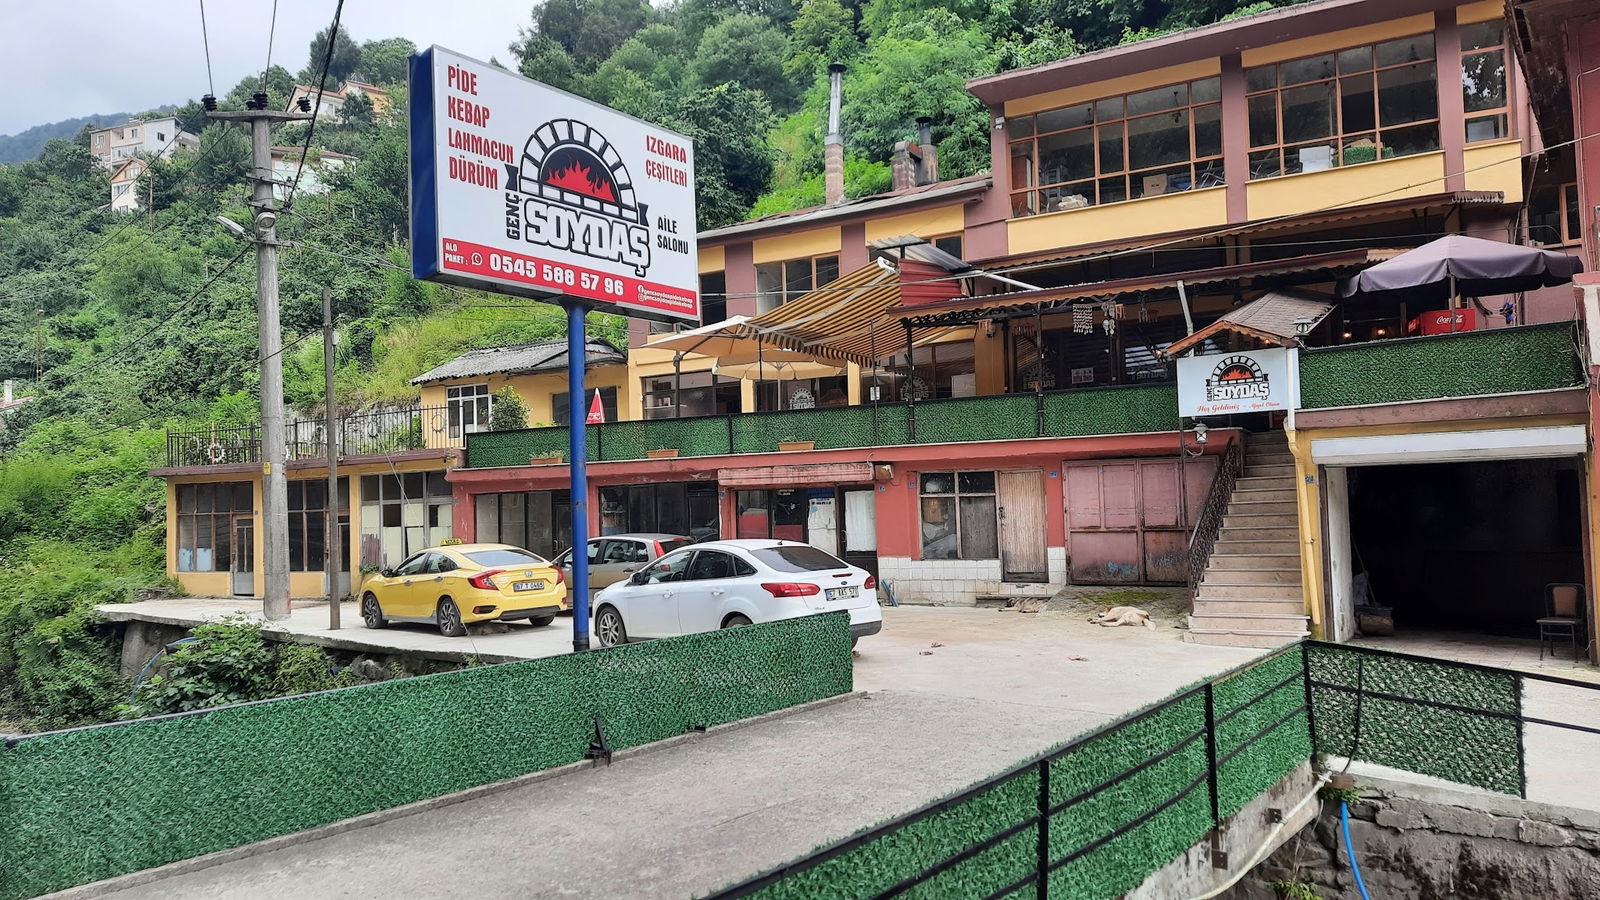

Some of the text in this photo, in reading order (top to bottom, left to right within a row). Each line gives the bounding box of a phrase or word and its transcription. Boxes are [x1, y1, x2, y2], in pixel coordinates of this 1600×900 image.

[448, 64, 478, 96] PİDE
[448, 95, 490, 128] KEBAP
[448, 127, 514, 164] LAHMACUN
[646, 134, 687, 163] IZGARA
[449, 155, 498, 190] DÜRÜM
[645, 159, 688, 188] ÇEŞİTLERİ
[506, 192, 522, 240] GENÇ
[657, 214, 677, 234] AİLE
[445, 242, 458, 252] ALO
[525, 198, 651, 277] SOYDAŞ
[657, 234, 689, 255] SALONU
[489, 253, 624, 296] 0545 588 57 96
[1213, 382, 1270, 400] SOYDAŞ
